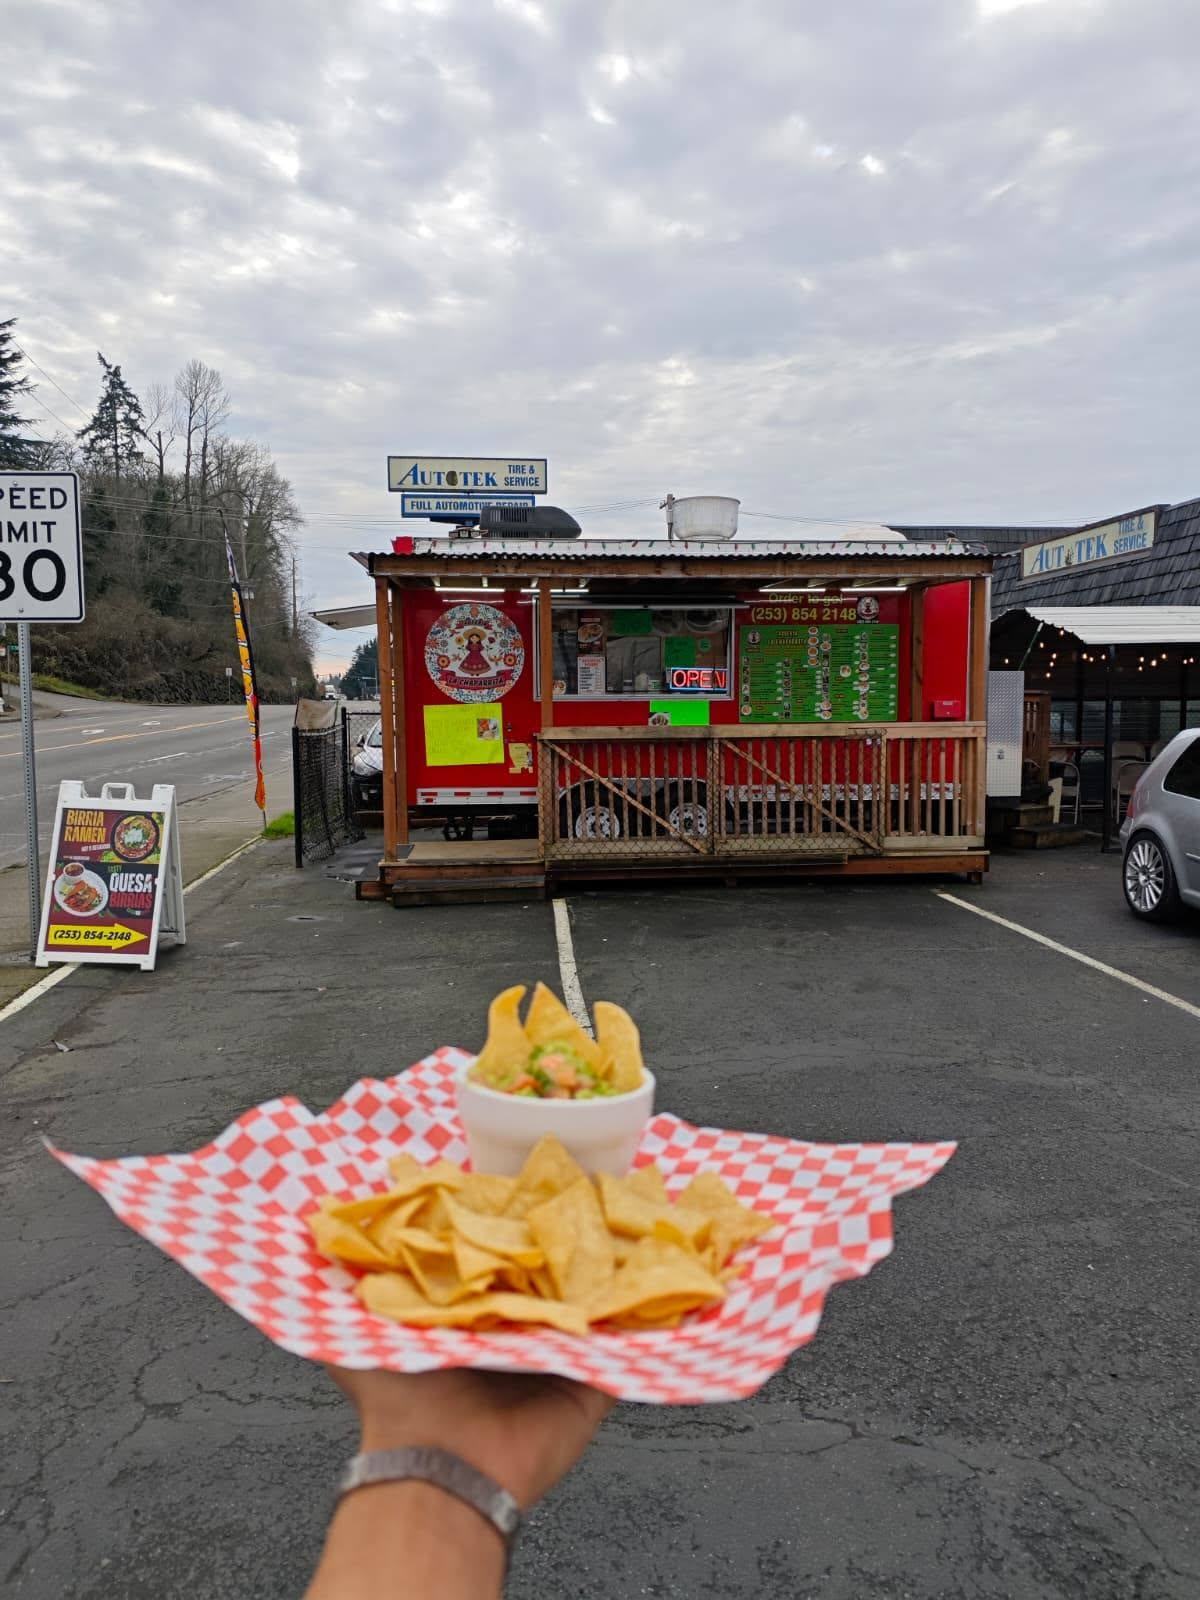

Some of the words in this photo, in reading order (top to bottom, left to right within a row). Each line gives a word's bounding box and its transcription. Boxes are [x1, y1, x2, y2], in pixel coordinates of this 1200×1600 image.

[508, 464, 527, 474] TIRE
[528, 465, 535, 474] &
[504, 476, 540, 487] SERVICE
[410, 500, 432, 510] FULL
[1119, 517, 1136, 534] TIRE
[1114, 532, 1148, 553] SERVICE
[769, 593, 804, 603] Order
[751, 607, 787, 623] (253)
[792, 607, 818, 620] 854
[822, 607, 857, 620] 2148
[672, 670, 727, 688] OPEN
[66, 809, 104, 826] BIRRIA
[64, 826, 107, 843] RAMEN
[109, 872, 153, 893] QUESA
[54, 929, 81, 940] (253)
[83, 929, 132, 941] 854-2148
